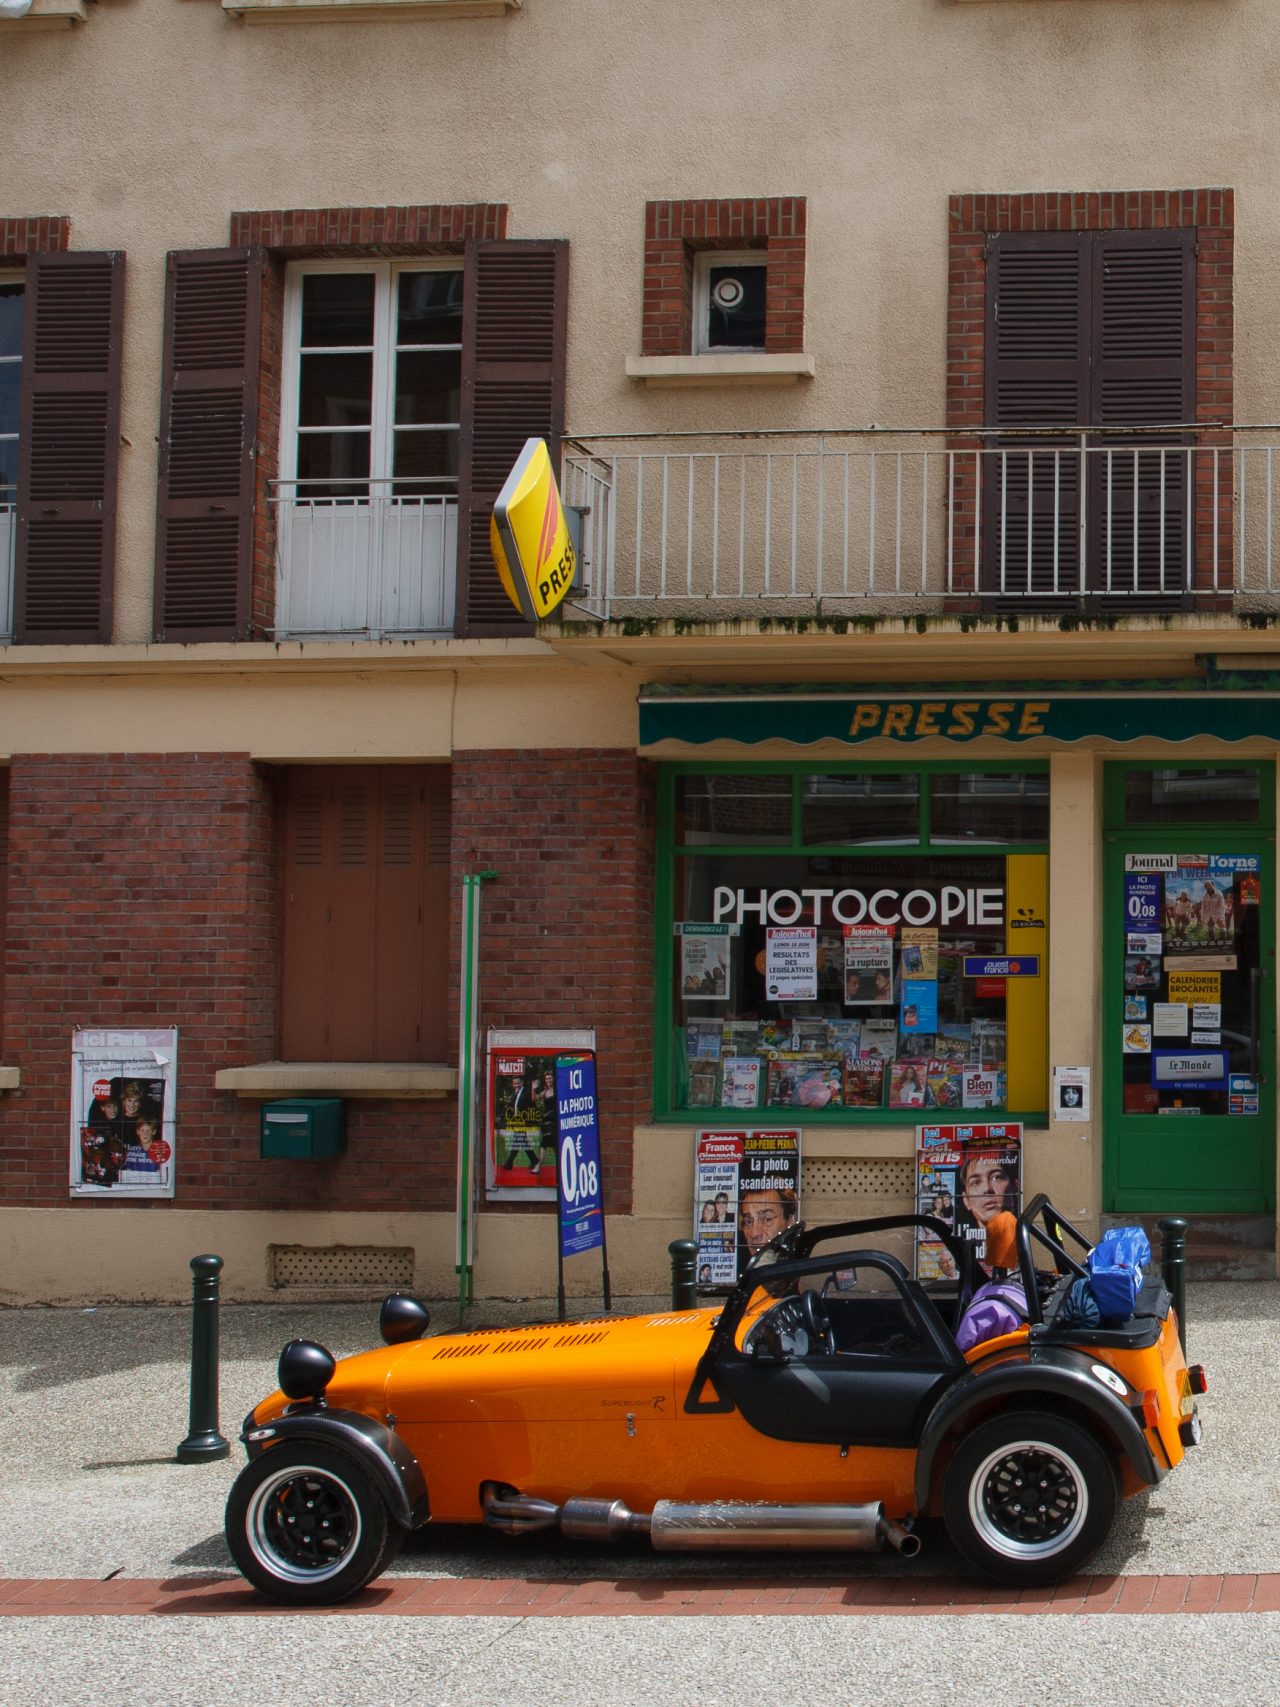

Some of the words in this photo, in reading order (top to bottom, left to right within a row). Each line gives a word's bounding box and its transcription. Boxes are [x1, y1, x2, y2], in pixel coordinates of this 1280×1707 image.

[539, 538, 574, 606] PRESS
[848, 703, 1050, 736] PRESSE
[1130, 855, 1173, 869] Journal
[1210, 855, 1258, 868] l'orne
[713, 886, 1003, 925] PHOTOCOPIE
[851, 928, 888, 937] Aujourd'hui
[846, 959, 855, 967] La
[857, 959, 888, 968] rupture
[1170, 976, 1219, 984] CALENDRIER
[1170, 985, 1219, 993] BROCANTES
[83, 1032, 105, 1046] Ici
[107, 1032, 147, 1046] Paris
[494, 1033, 527, 1045] France
[533, 1033, 588, 1045] Dimanche
[499, 1059, 524, 1074] MATCH
[929, 1061, 952, 1071] Pif
[1168, 1061, 1178, 1070] Le
[1180, 1061, 1212, 1070] Monde
[569, 1069, 582, 1090] ICI
[967, 1080, 992, 1090] Bien
[967, 1089, 992, 1097] manger
[559, 1100, 569, 1115] LA
[569, 1095, 594, 1112] PHOTO
[560, 1112, 594, 1130] NUMÉRIQUE
[705, 1143, 736, 1151] France
[699, 1152, 743, 1160] Dimanche
[919, 1151, 961, 1163] Paris
[751, 1158, 761, 1171] La
[764, 1158, 789, 1174] photo
[740, 1175, 795, 1190] scandaleuse
[652, 1395, 666, 1412] R
